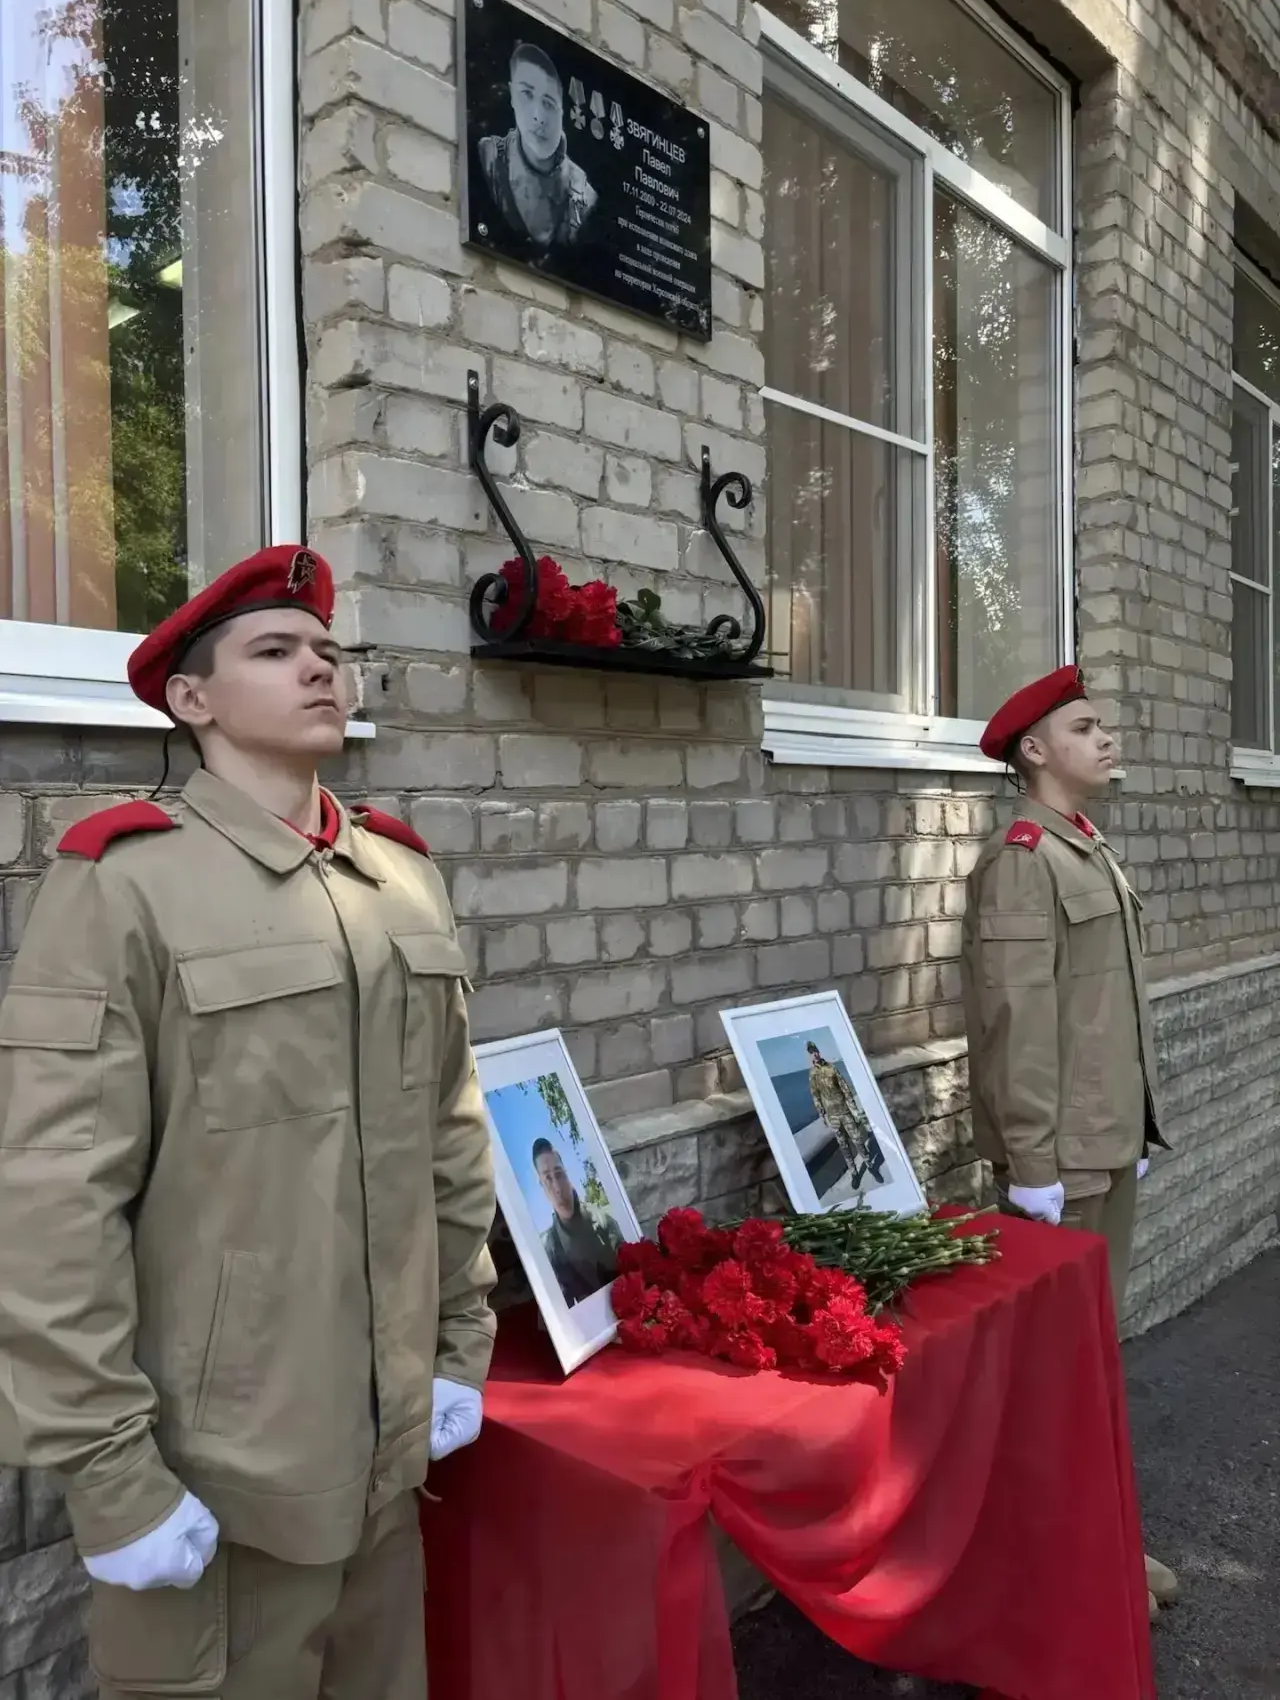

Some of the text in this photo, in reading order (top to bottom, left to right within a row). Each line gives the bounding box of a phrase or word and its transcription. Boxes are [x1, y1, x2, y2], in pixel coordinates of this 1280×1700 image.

[626, 118, 686, 163] ЗВЯГИНЦЕВ
[642, 148, 672, 177] Павел
[634, 165, 680, 202] Павлович
